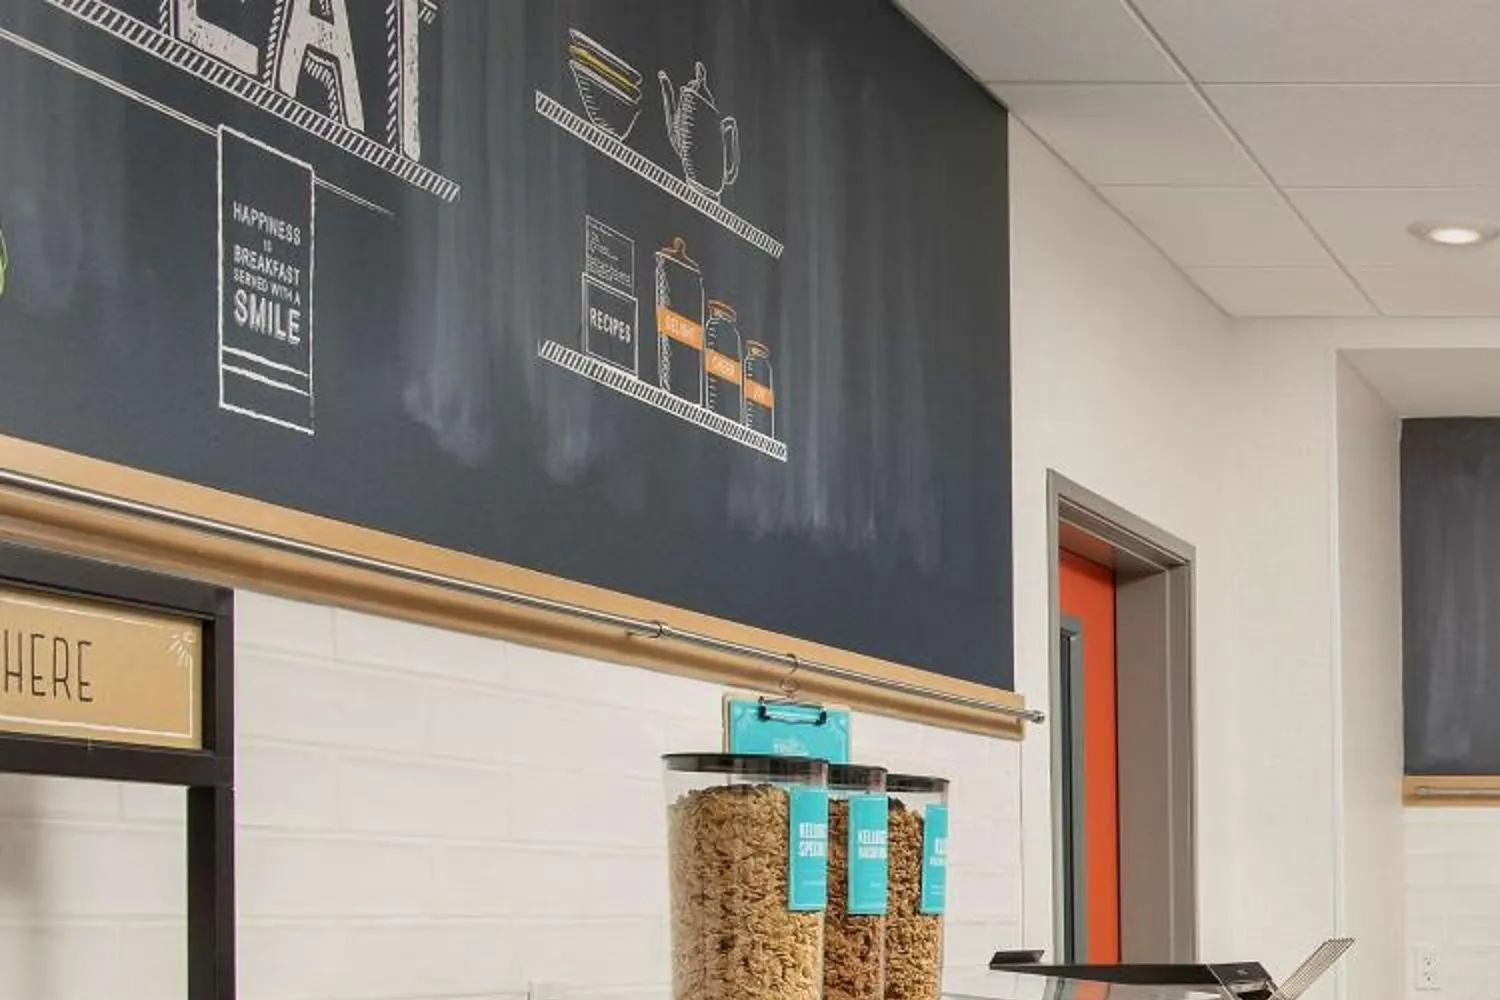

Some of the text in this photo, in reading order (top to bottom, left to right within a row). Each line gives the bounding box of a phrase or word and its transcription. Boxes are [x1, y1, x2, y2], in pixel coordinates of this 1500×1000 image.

[233, 201, 300, 246] HAPPINESS
[233, 244, 300, 286] BREAKFAST
[233, 267, 269, 293] SERVED
[293, 291, 301, 306] A
[233, 288, 301, 345] SMILE
[589, 307, 632, 345] RECIPES
[3, 629, 94, 703] HERE
